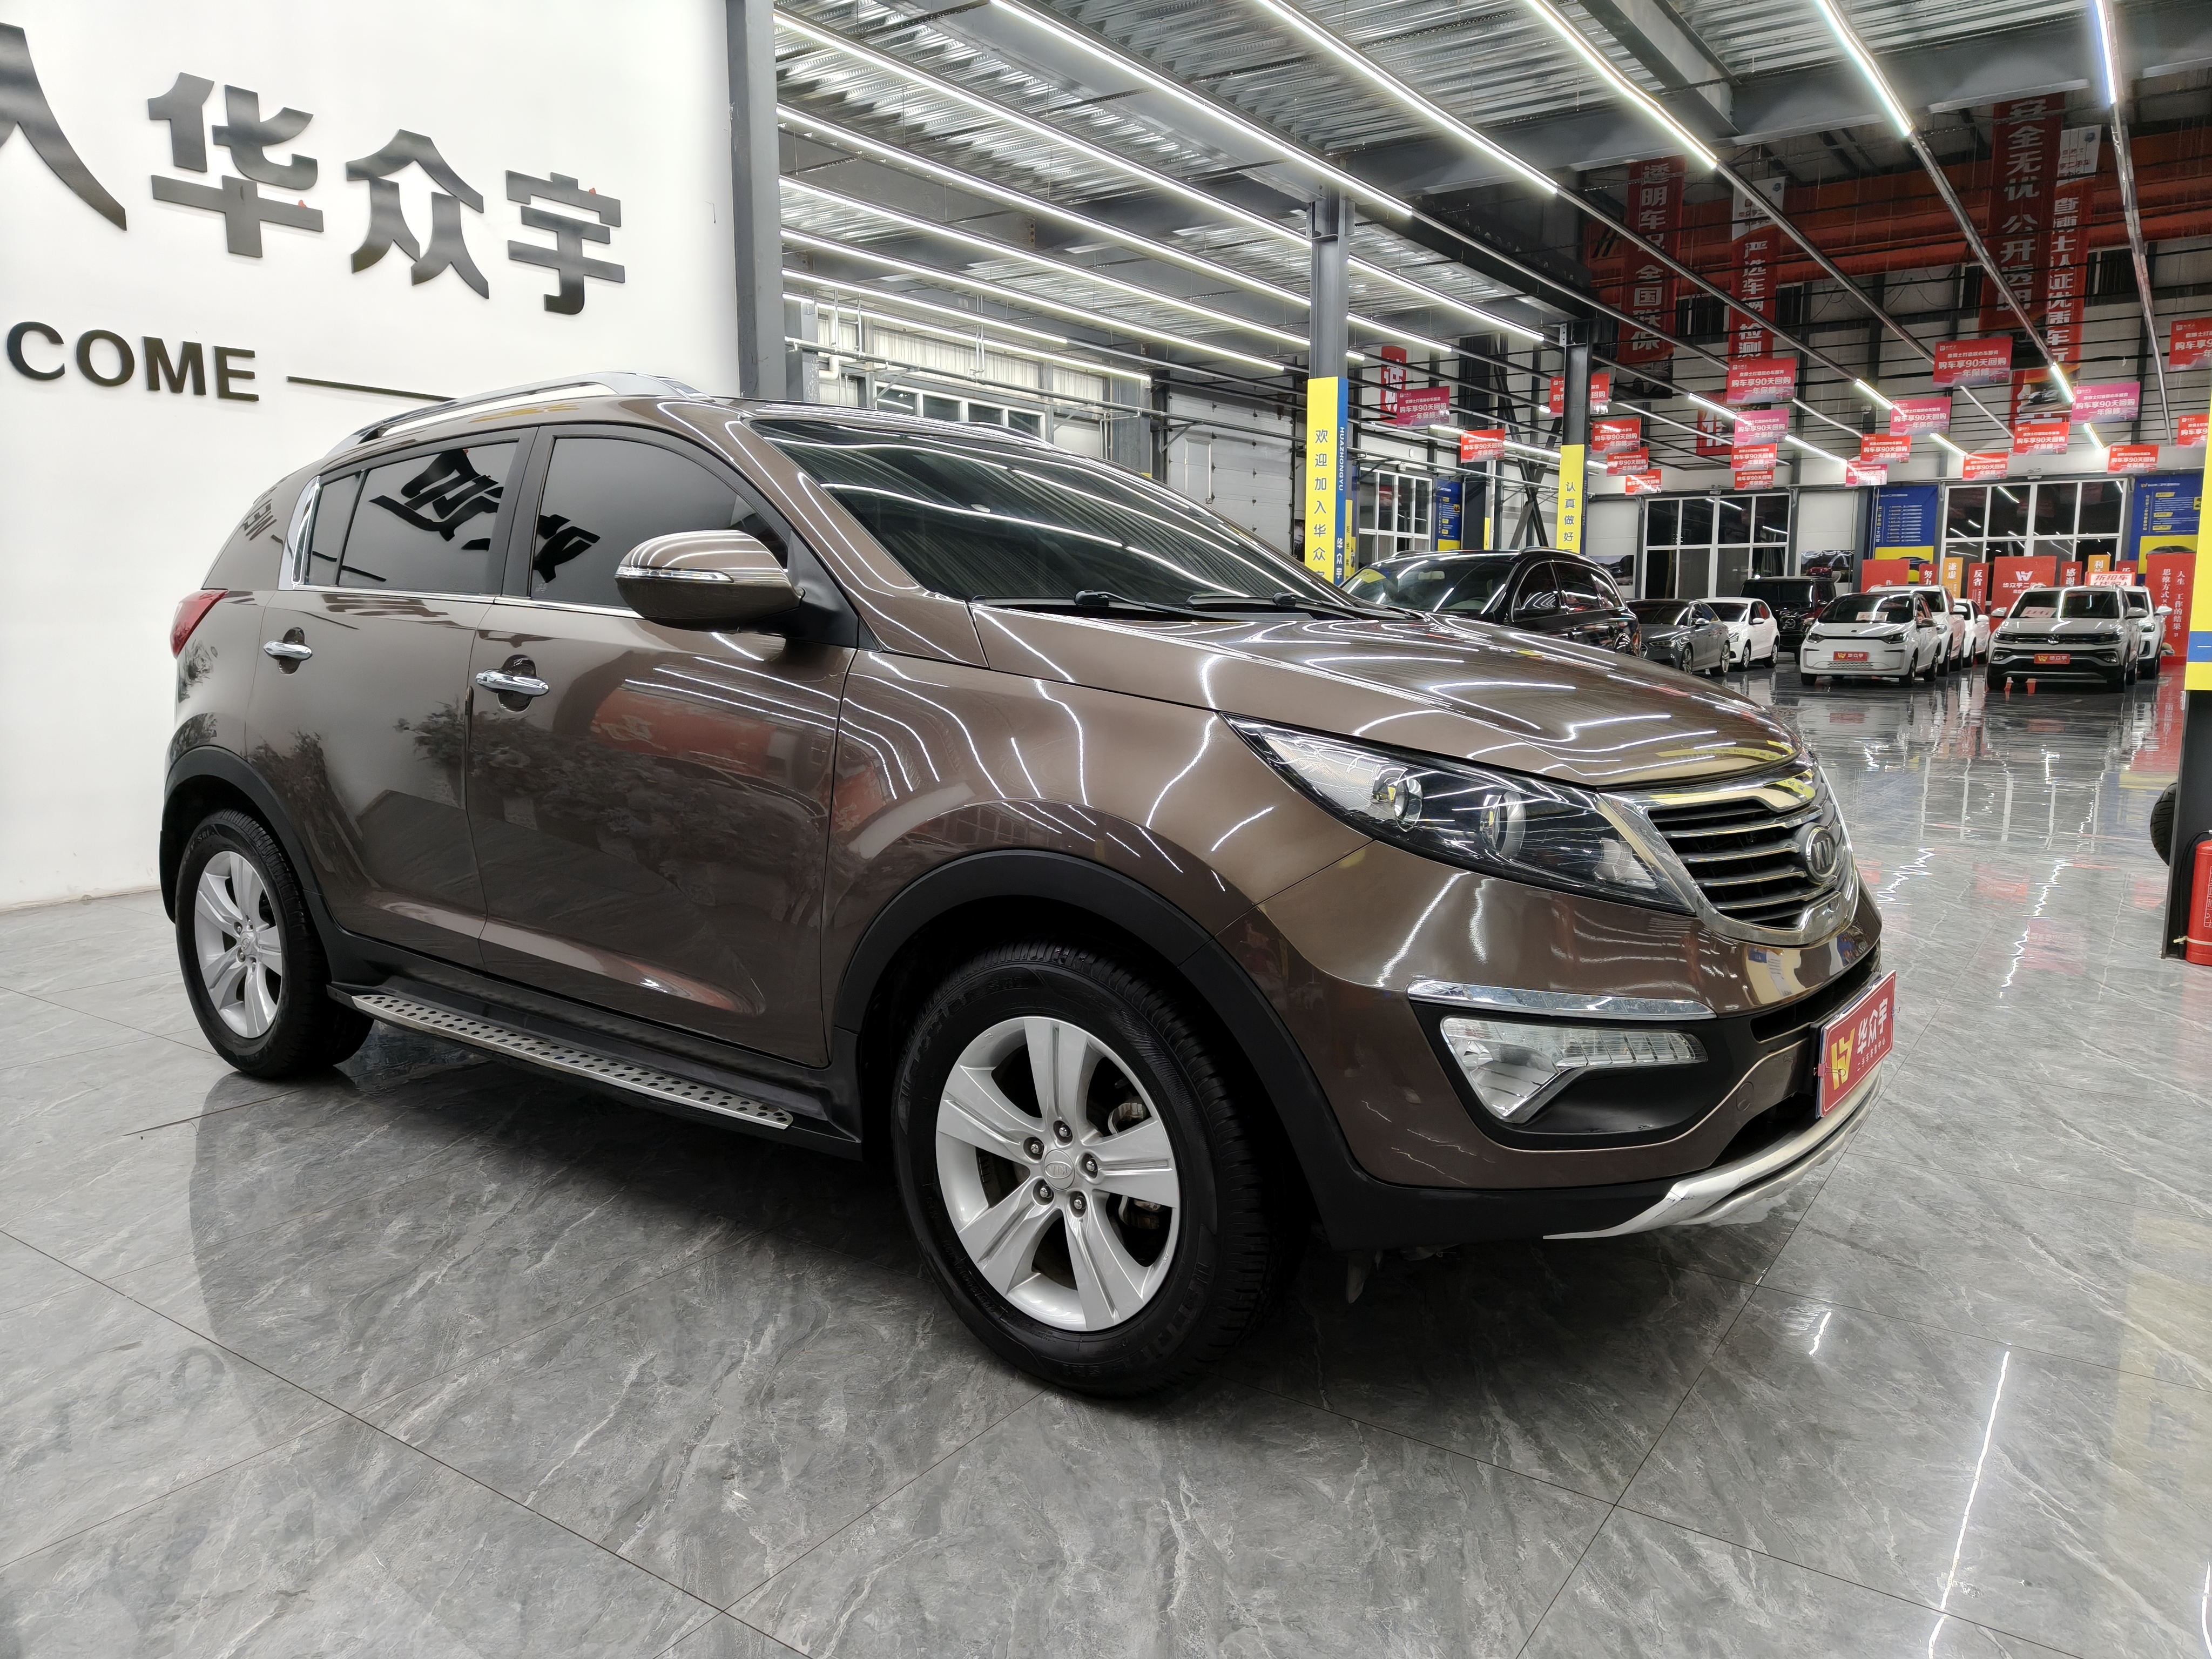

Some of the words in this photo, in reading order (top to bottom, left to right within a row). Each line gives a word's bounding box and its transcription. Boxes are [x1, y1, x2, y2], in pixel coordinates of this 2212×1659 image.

[1631, 265, 1663, 351] 全国联保
[6, 321, 260, 402] COME
[1738, 322, 1763, 361] 检测
[1563, 481, 1576, 550] 认真做好
[1973, 570, 1983, 586] 反省
[1857, 997, 1888, 1054] 华众宇
